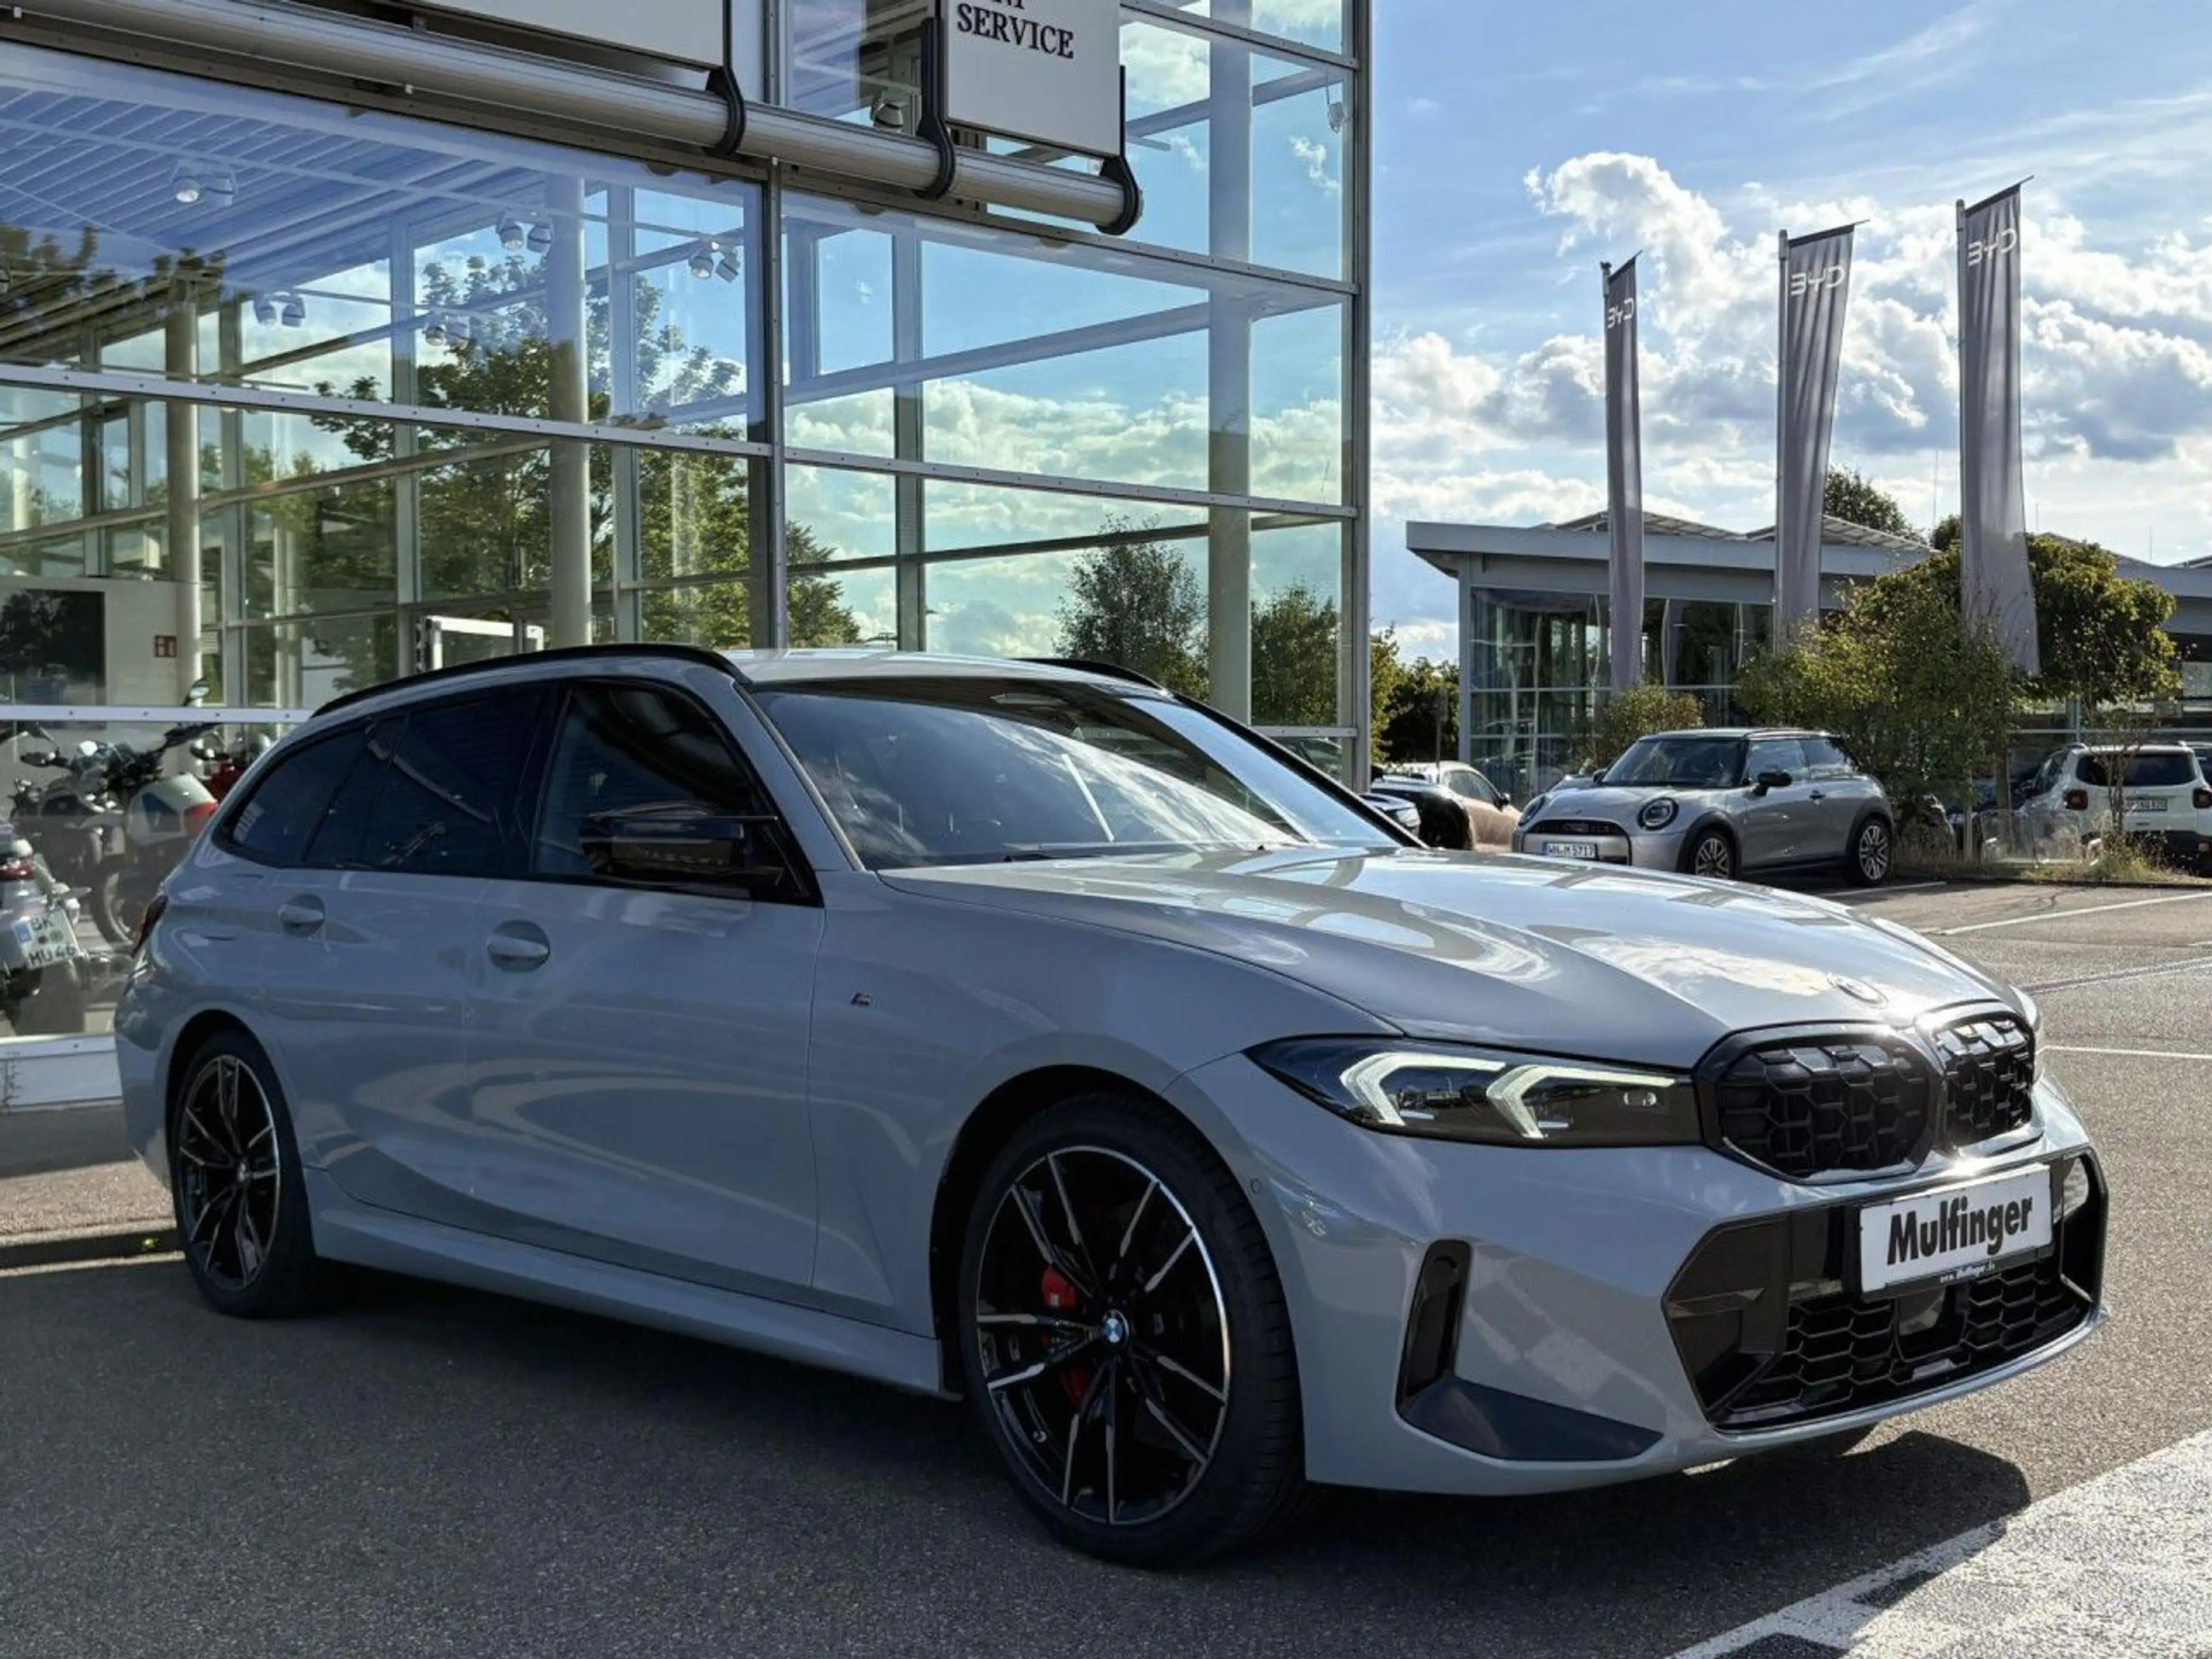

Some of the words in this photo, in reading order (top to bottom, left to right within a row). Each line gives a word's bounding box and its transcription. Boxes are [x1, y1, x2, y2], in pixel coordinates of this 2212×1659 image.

[957, 3, 1074, 59] SERVICE
[1967, 228, 2017, 266] BYD
[1790, 266, 1846, 296] BYD
[1607, 297, 1634, 329] BYD
[1887, 1195, 2033, 1265] Mulfinger
